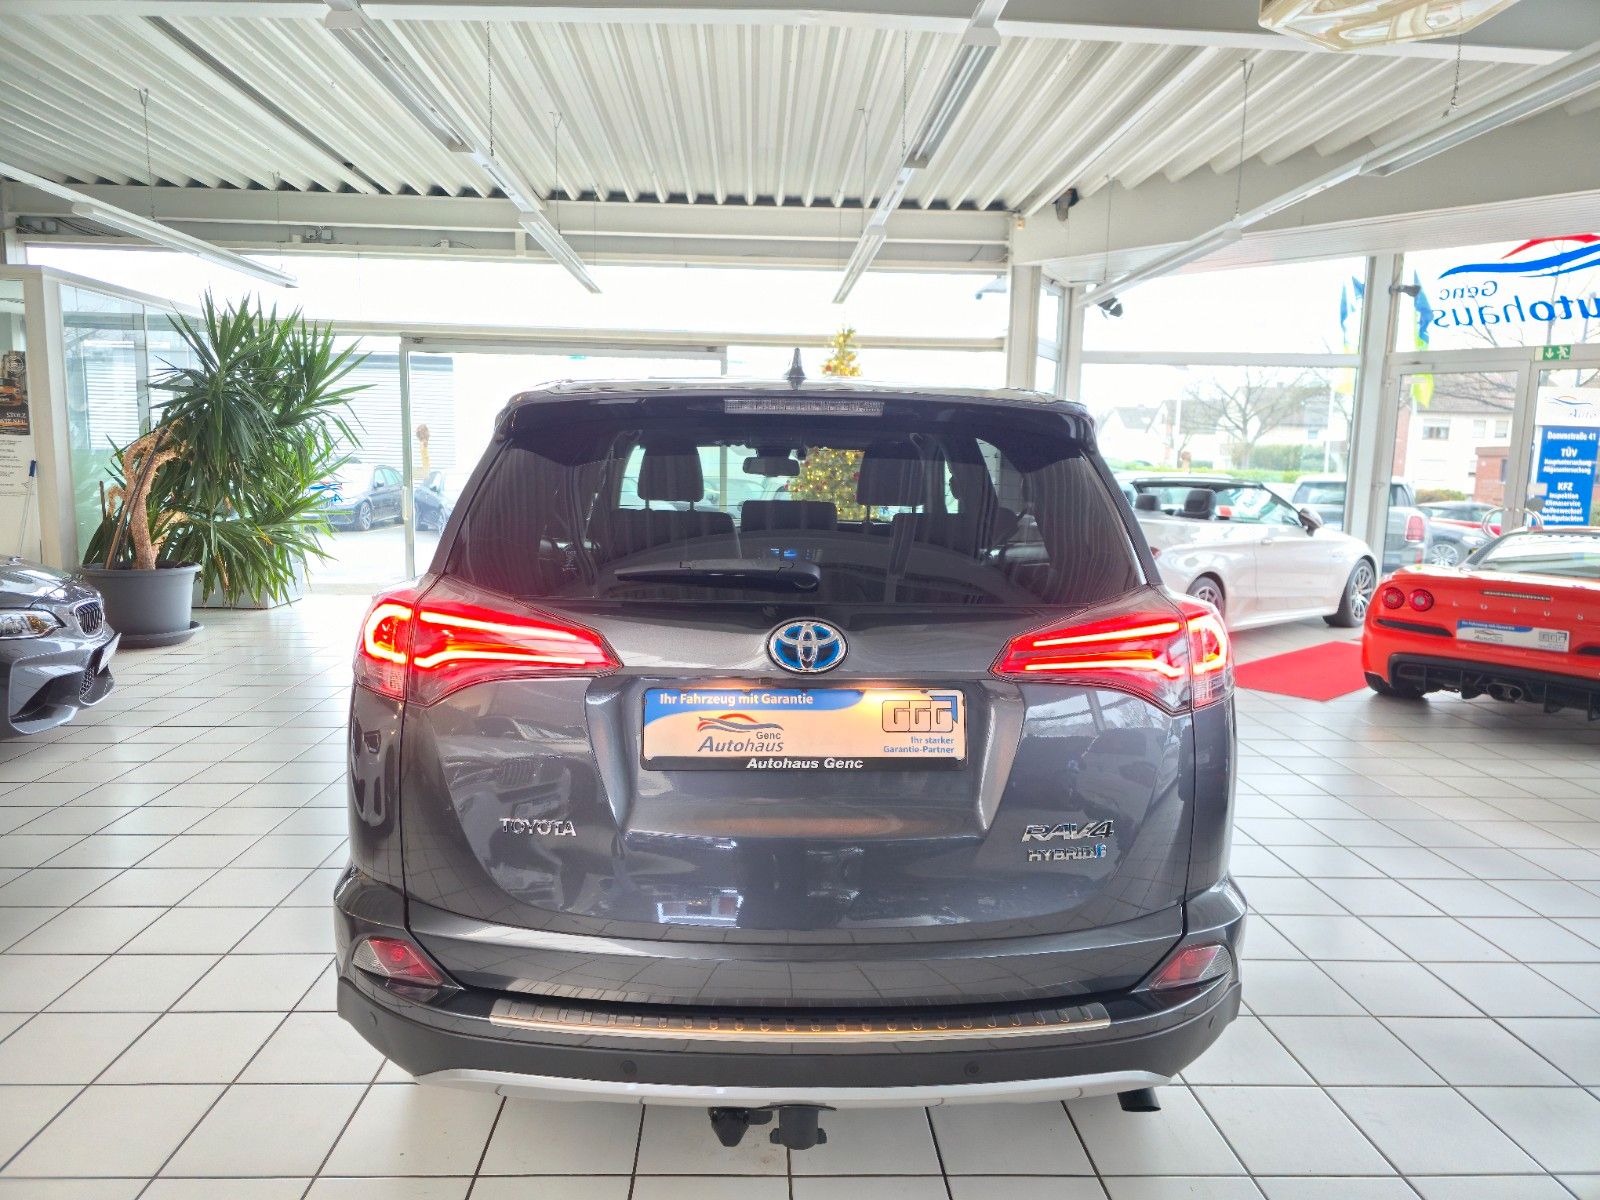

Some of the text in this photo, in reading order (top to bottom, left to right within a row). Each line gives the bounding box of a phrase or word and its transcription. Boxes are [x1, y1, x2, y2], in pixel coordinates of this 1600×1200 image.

[1588, 432, 1596, 441] 41
[1561, 446, 1578, 457] TÜV
[1557, 482, 1573, 491] KFZ
[1549, 492, 1579, 500] Inspektion
[1545, 499, 1581, 507] Klimaservice
[1453, 600, 1583, 620] LOTUS
[660, 693, 813, 707] Ihr Fahrzeug mit Garantie
[882, 700, 954, 733] GGG
[756, 731, 782, 740] Genc
[910, 736, 954, 744] Ihr starker
[698, 736, 784, 752] Autohaus
[883, 745, 955, 754] Garantie-Partner
[746, 757, 864, 769] Autohaus Genc
[499, 817, 577, 837] TOYOTA
[1021, 820, 1115, 842] RAV4
[1028, 845, 1097, 862] HYBRID
